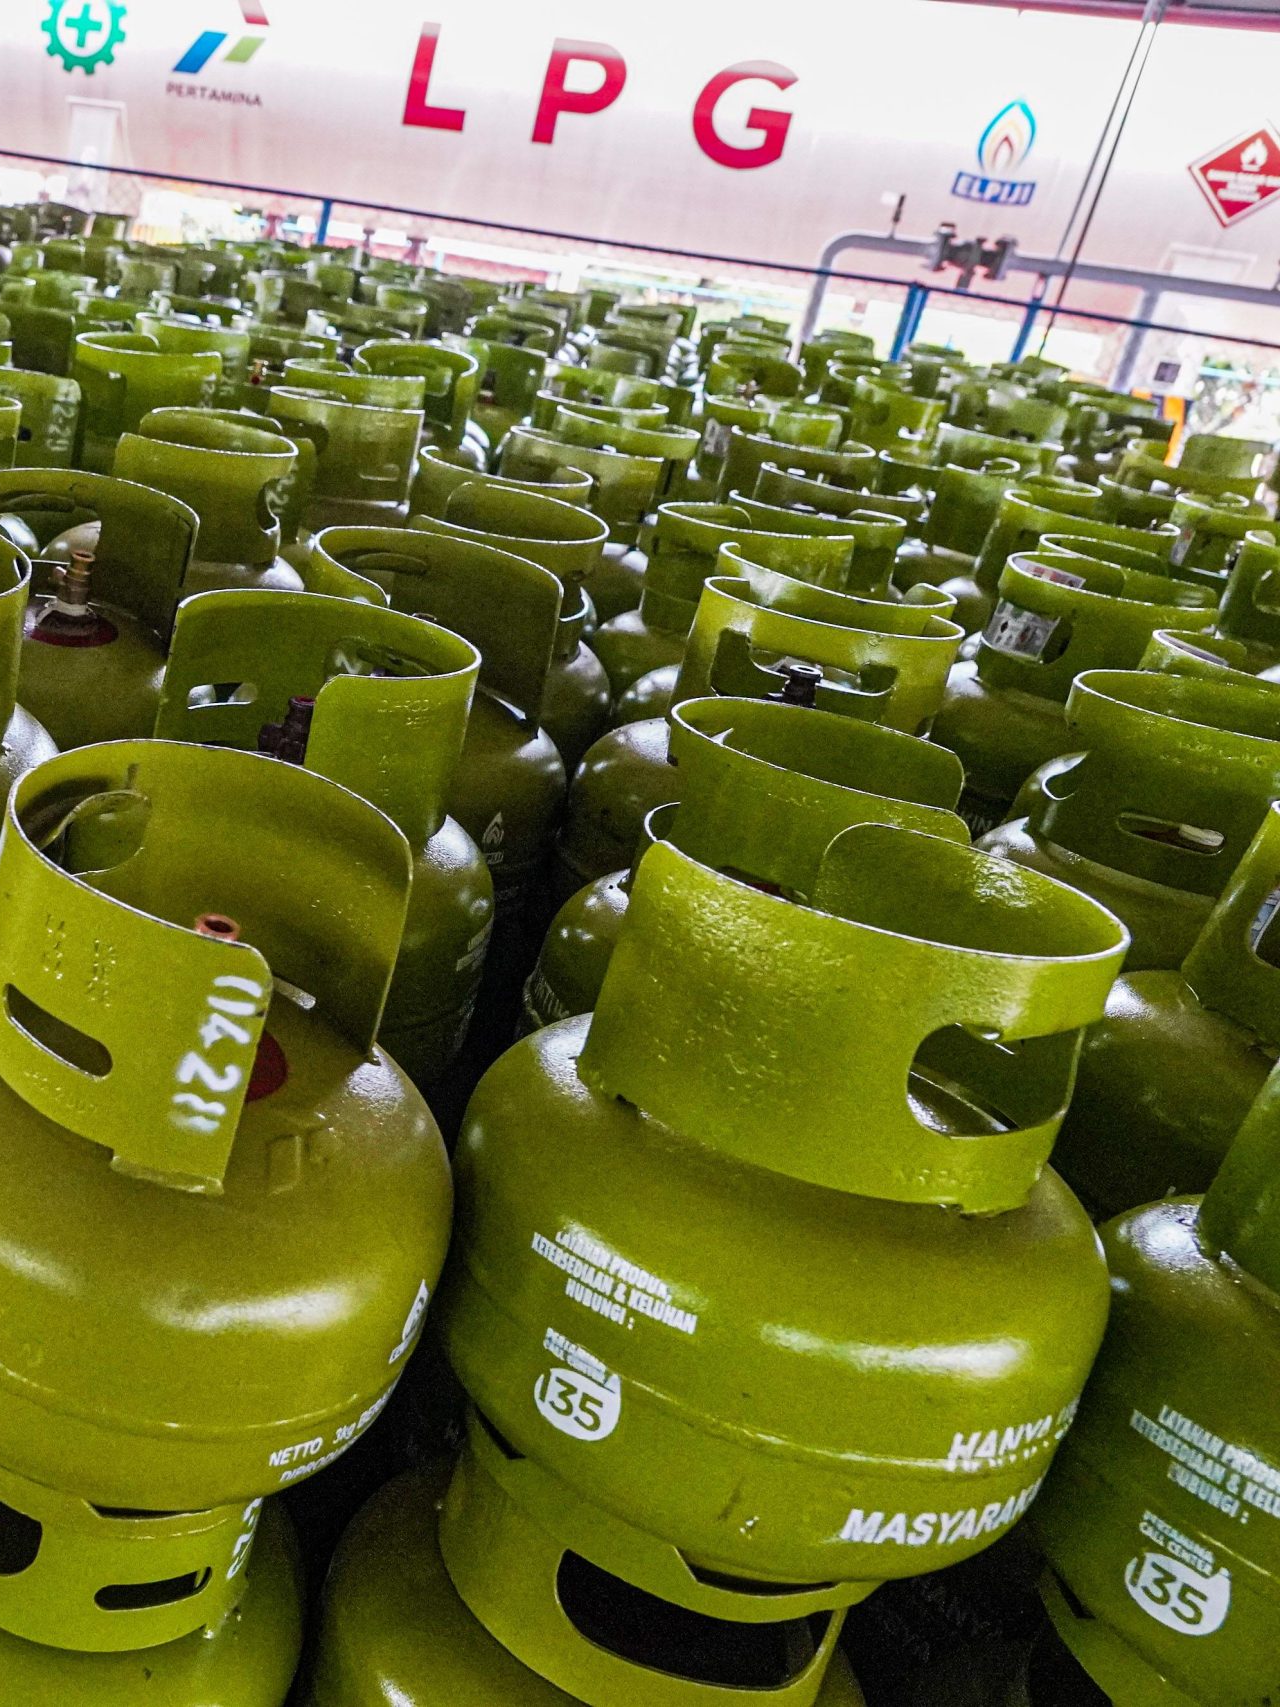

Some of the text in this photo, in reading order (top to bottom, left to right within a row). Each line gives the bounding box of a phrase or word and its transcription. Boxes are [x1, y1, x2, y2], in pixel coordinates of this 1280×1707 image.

[165, 81, 262, 106] PERTAMINA
[955, 176, 1032, 204] ELPIJI
[565, 1278, 627, 1325] HUBUNGI
[628, 1288, 698, 1335] KELUHAN
[539, 1374, 604, 1432] 135
[269, 1437, 324, 1467] NETTO
[1129, 1556, 1208, 1626] 135
